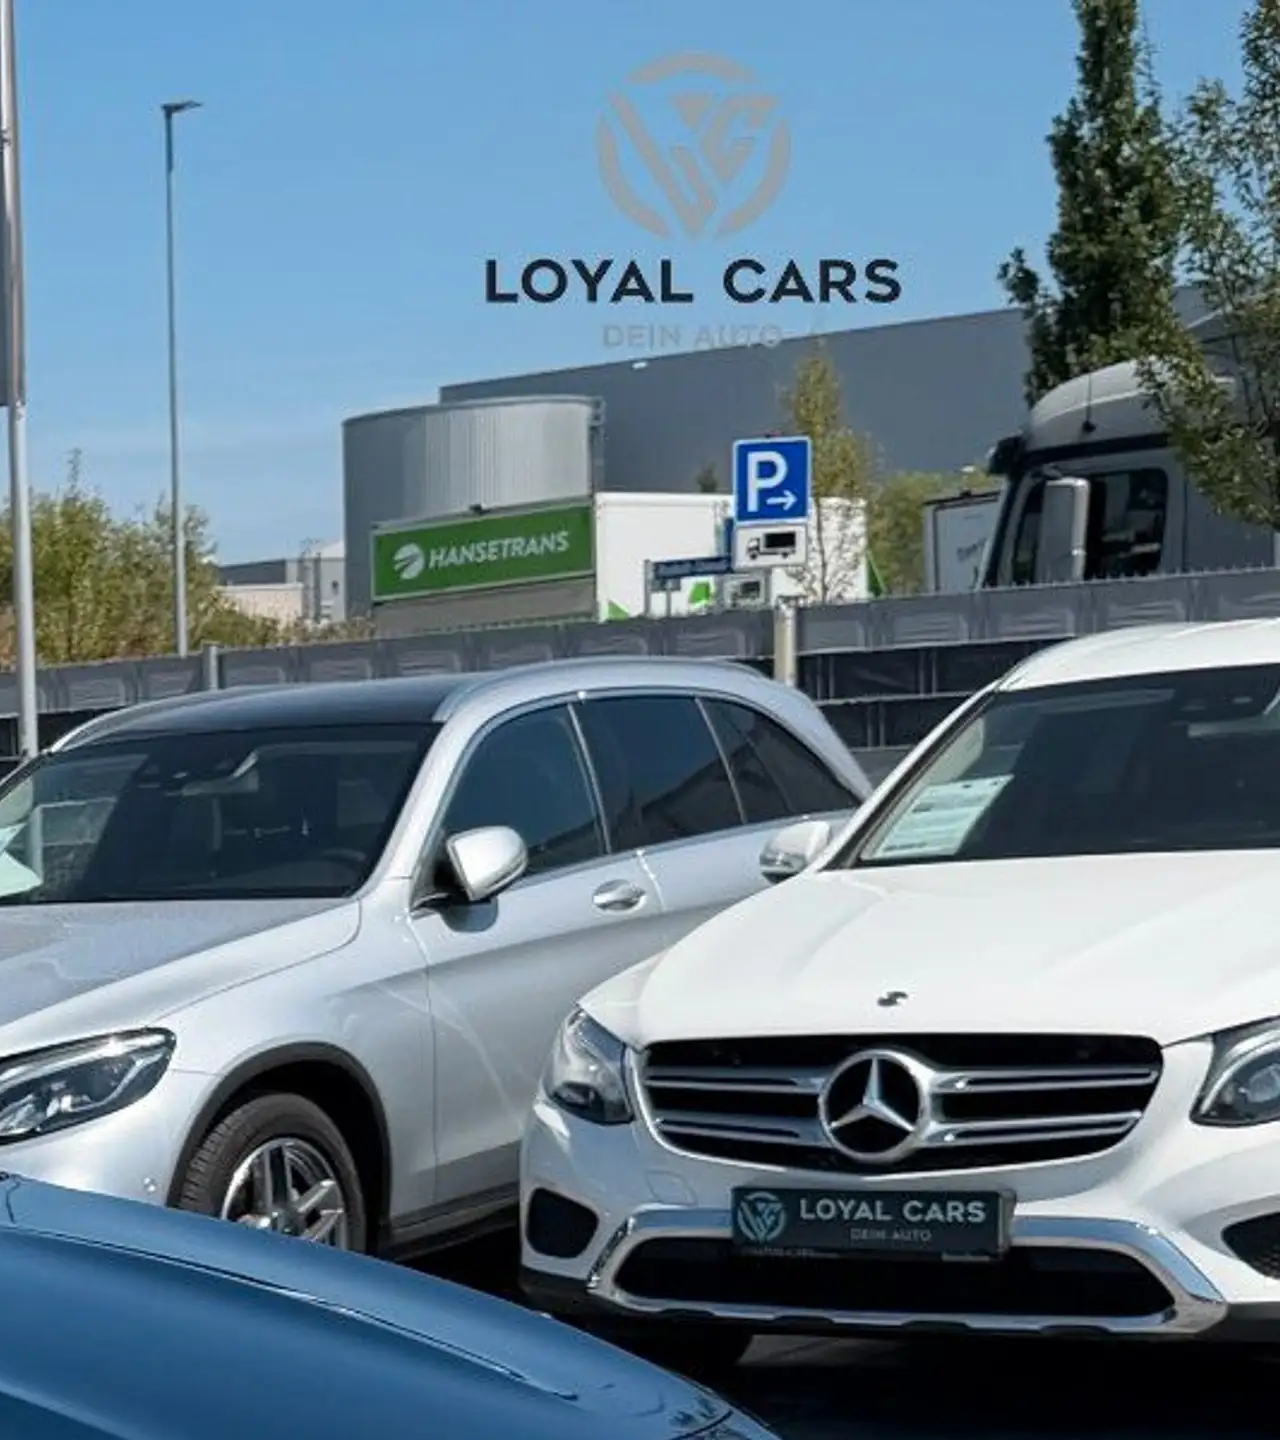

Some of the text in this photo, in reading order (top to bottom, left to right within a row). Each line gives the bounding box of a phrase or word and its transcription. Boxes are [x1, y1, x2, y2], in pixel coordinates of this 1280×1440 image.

[746, 451, 788, 512] P
[428, 531, 570, 568] HANSETRANS
[799, 1199, 987, 1223] LOYAL CARS
[892, 1229, 932, 1242] AUTO
